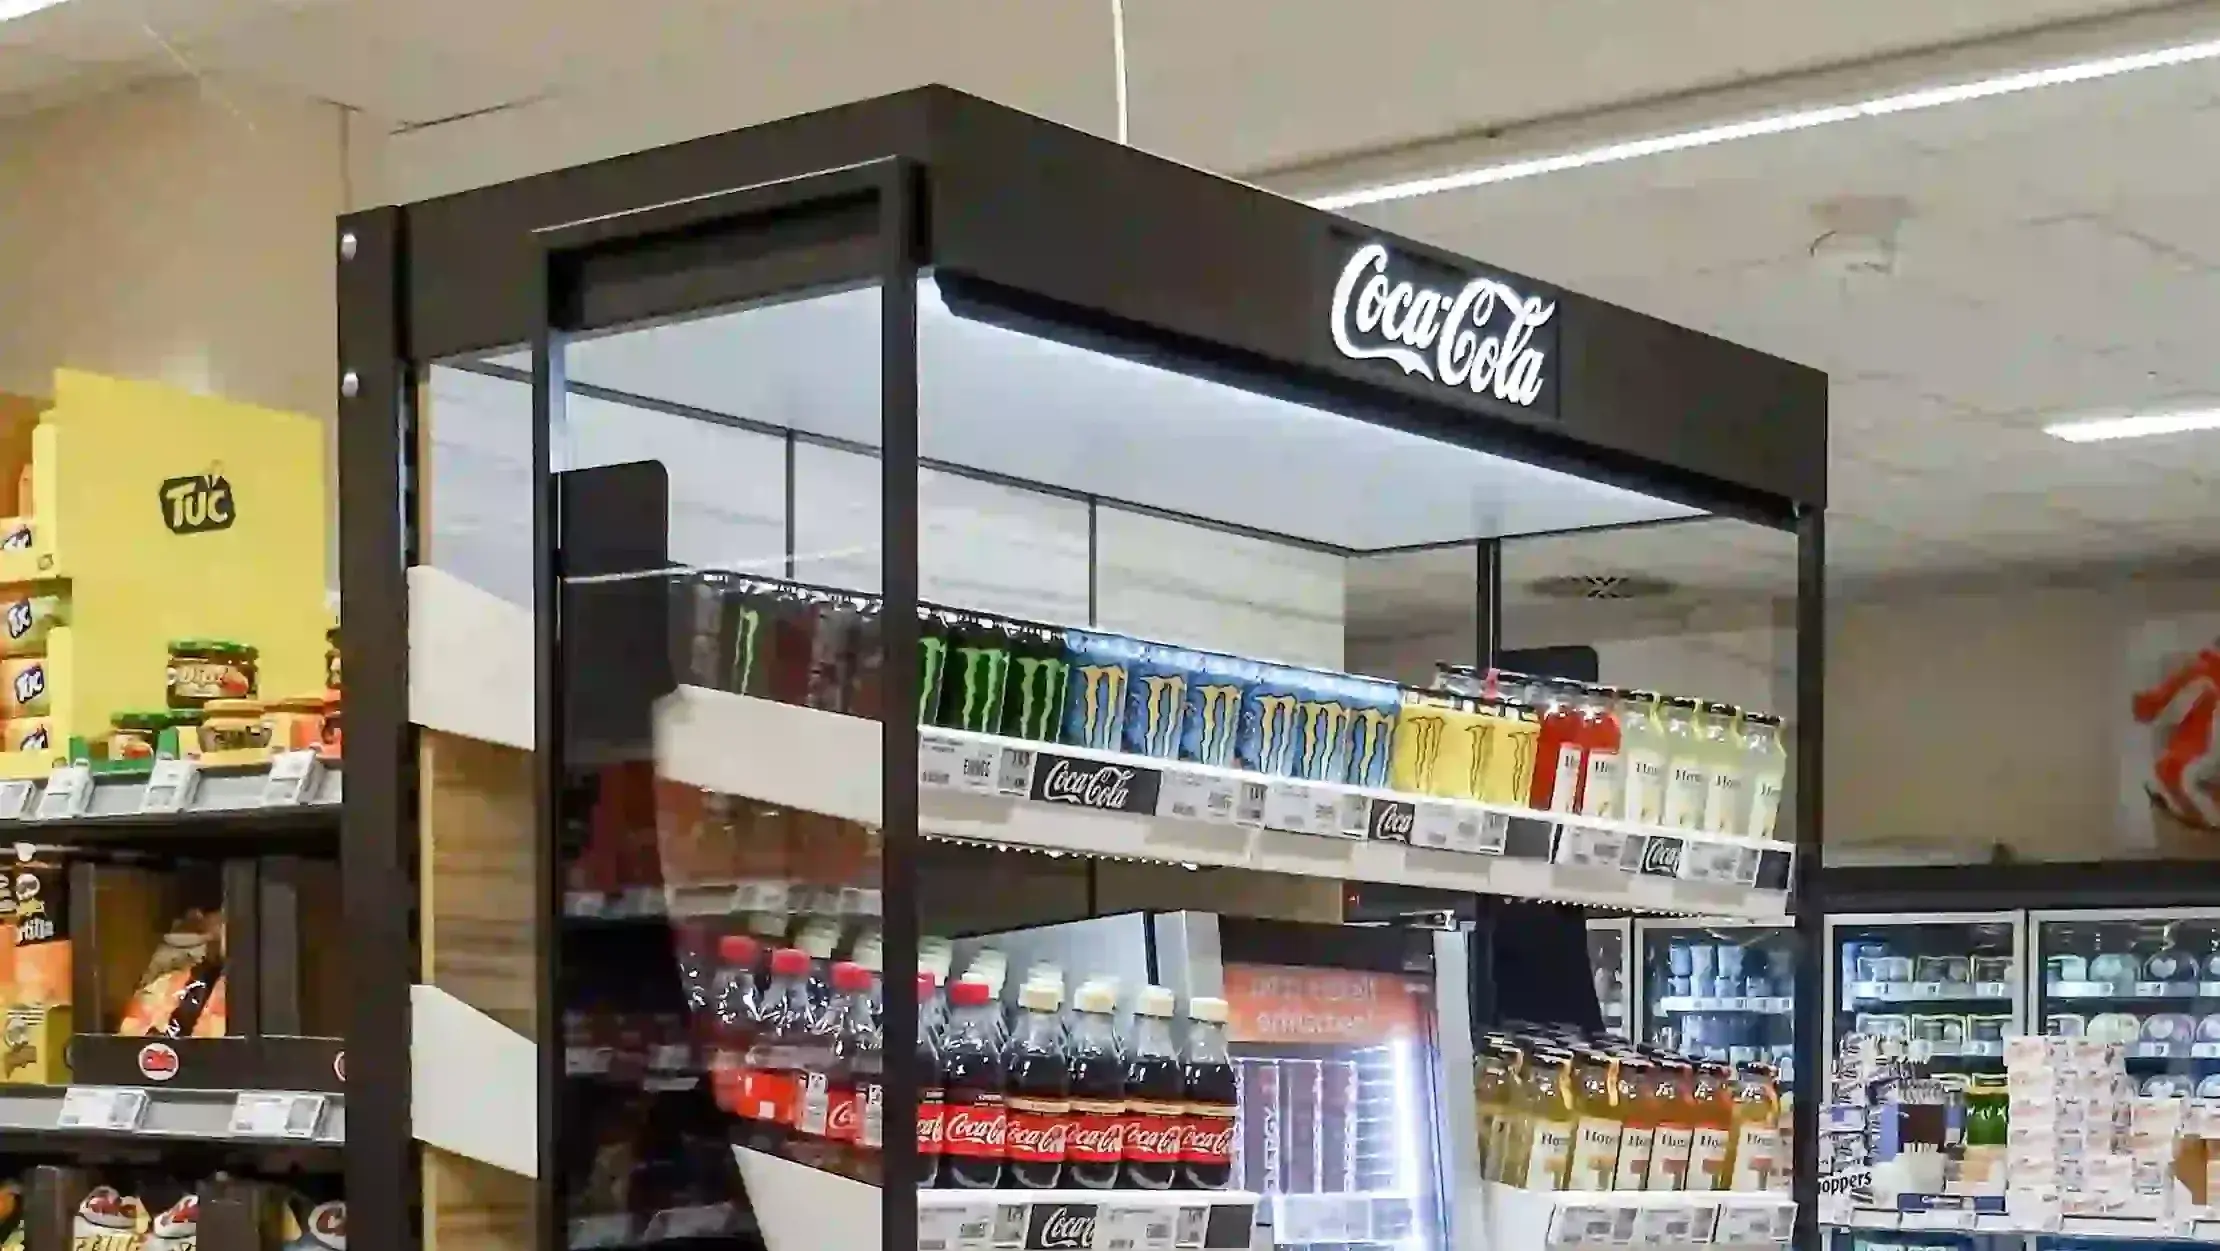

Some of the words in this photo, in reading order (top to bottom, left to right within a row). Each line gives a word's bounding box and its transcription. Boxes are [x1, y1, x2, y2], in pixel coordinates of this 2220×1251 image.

[1331, 244, 1556, 407] Coca-Cola
[166, 478, 229, 527] TUC
[1044, 759, 1136, 810] Coca-Cola
